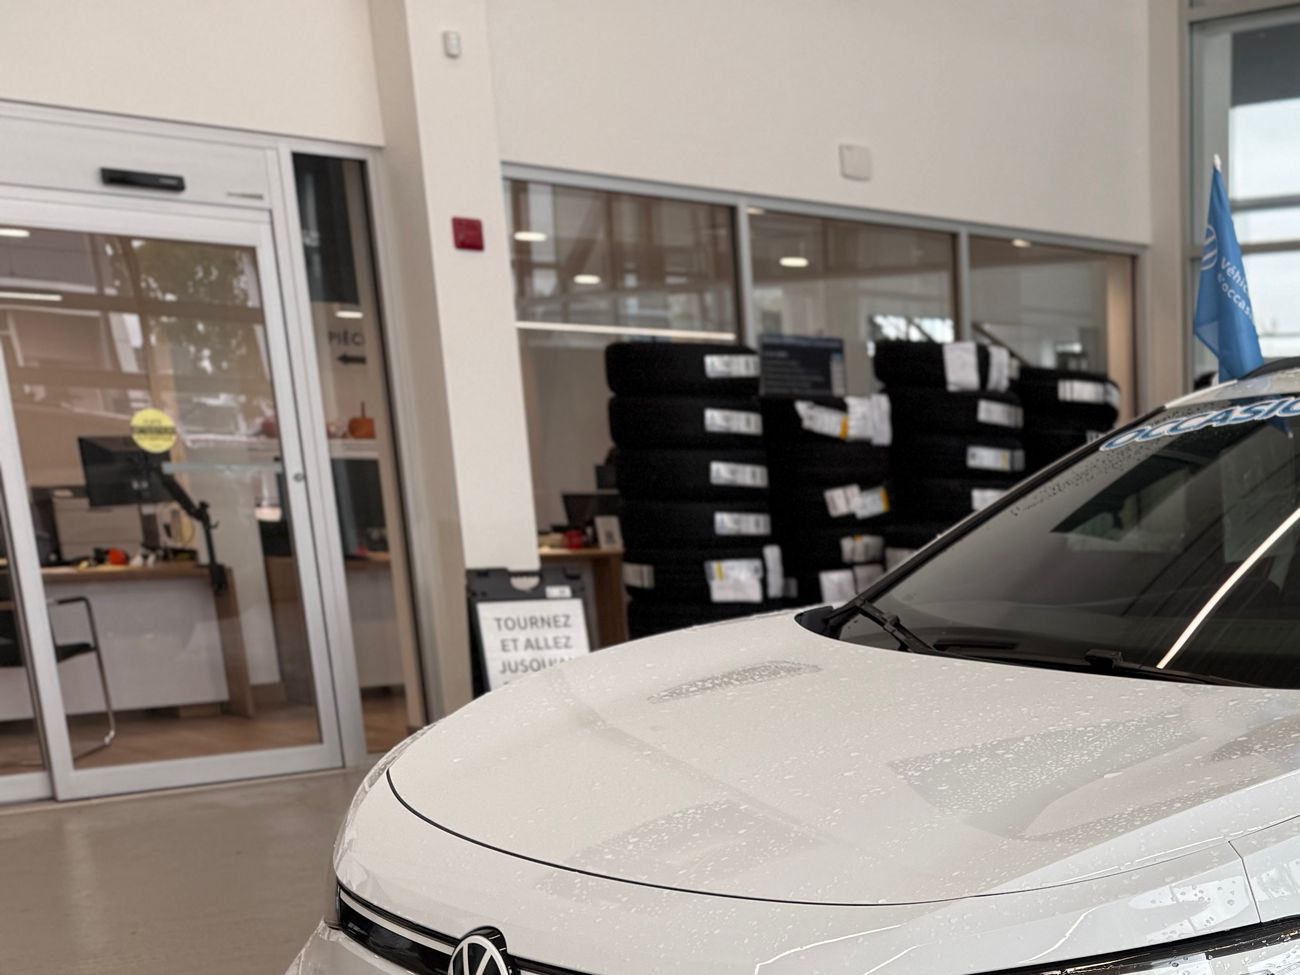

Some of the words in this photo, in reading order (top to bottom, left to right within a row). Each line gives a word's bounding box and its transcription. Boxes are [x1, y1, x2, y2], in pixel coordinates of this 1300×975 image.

[494, 613, 573, 631] TOURNEZ
[500, 637, 519, 653] ET
[523, 635, 574, 652] ALLEZ
